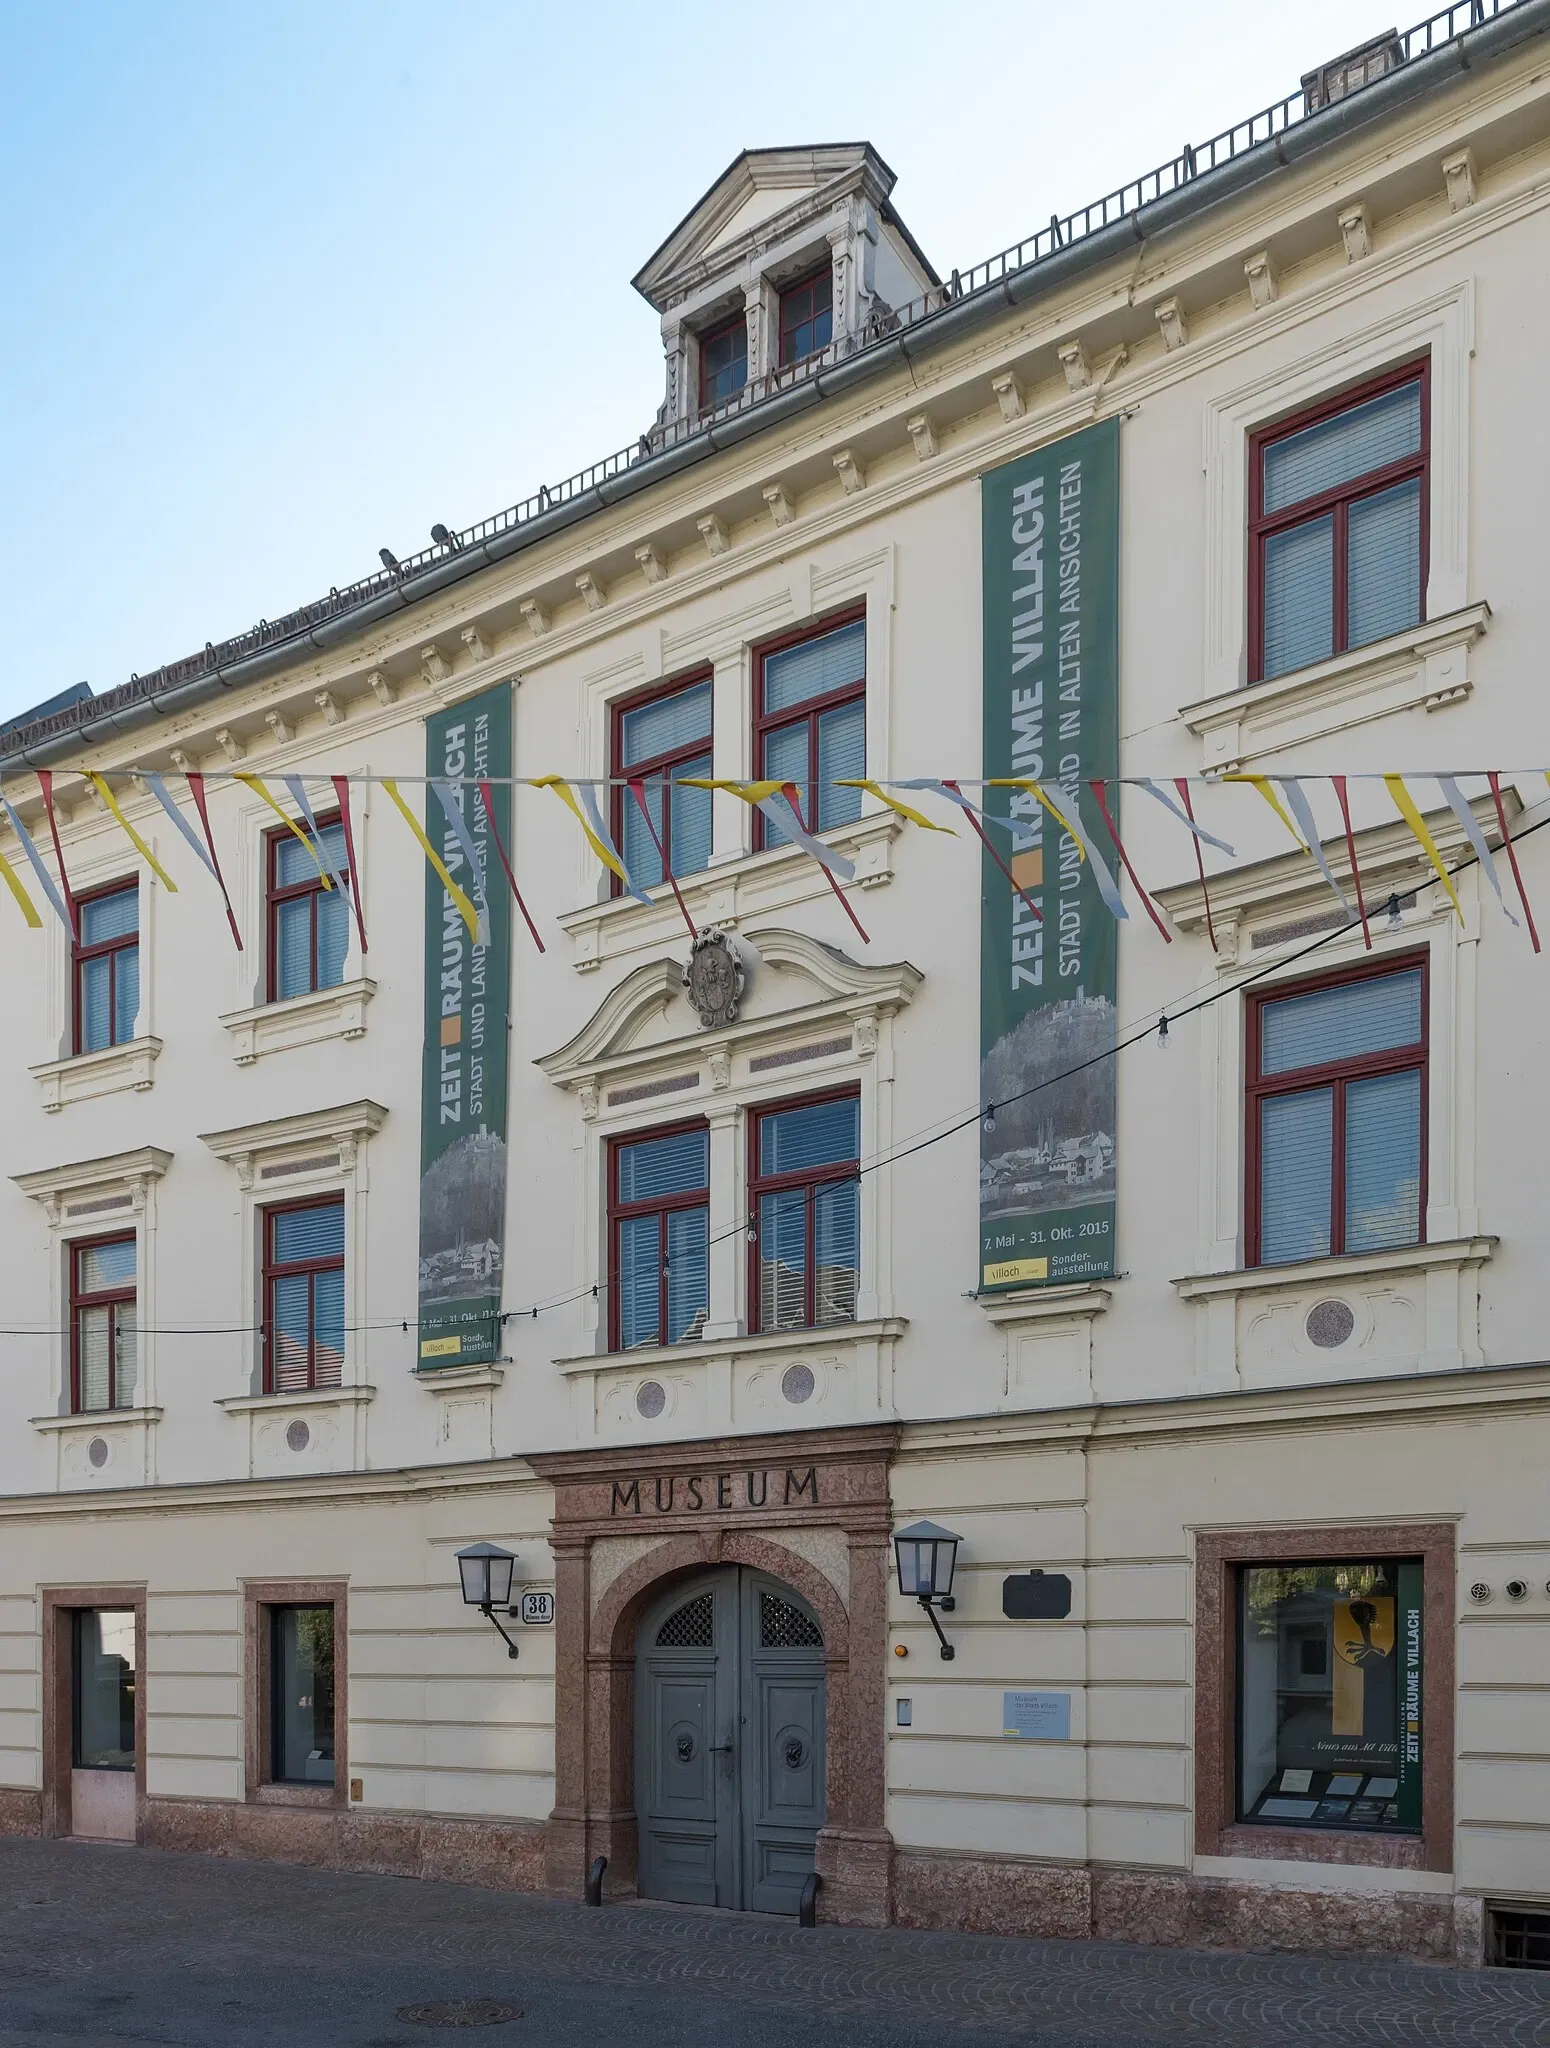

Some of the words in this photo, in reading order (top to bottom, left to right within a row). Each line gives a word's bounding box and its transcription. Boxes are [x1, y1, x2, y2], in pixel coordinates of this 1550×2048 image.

[1059, 460, 1082, 613] ANSICHTEN
[1011, 475, 1045, 675] VILLACH
[1059, 619, 1081, 702] ALTEN
[1059, 709, 1081, 741] IN
[1059, 829, 1081, 891] UND
[1011, 892, 1043, 990] ZEIT
[1059, 898, 1081, 978] STADT
[471, 943, 486, 997] LAND
[471, 1002, 485, 1049] UND
[440, 1048, 462, 1125] ZEIT
[470, 1055, 484, 1116] STADT
[996, 1234, 1015, 1249] Mai
[1029, 1231, 1047, 1244] 31.
[1050, 1227, 1075, 1241] Okt.
[1078, 1221, 1109, 1237] 2015
[1051, 1252, 1091, 1266] Sonder-
[1051, 1260, 1110, 1277] ausstellung
[610, 1467, 820, 1516] MUSEUM
[528, 1595, 547, 1614] 38
[1406, 1609, 1420, 1667] VILLACH
[1406, 1670, 1419, 1721] RÄUME
[1406, 1732, 1419, 1763] ZEIT
